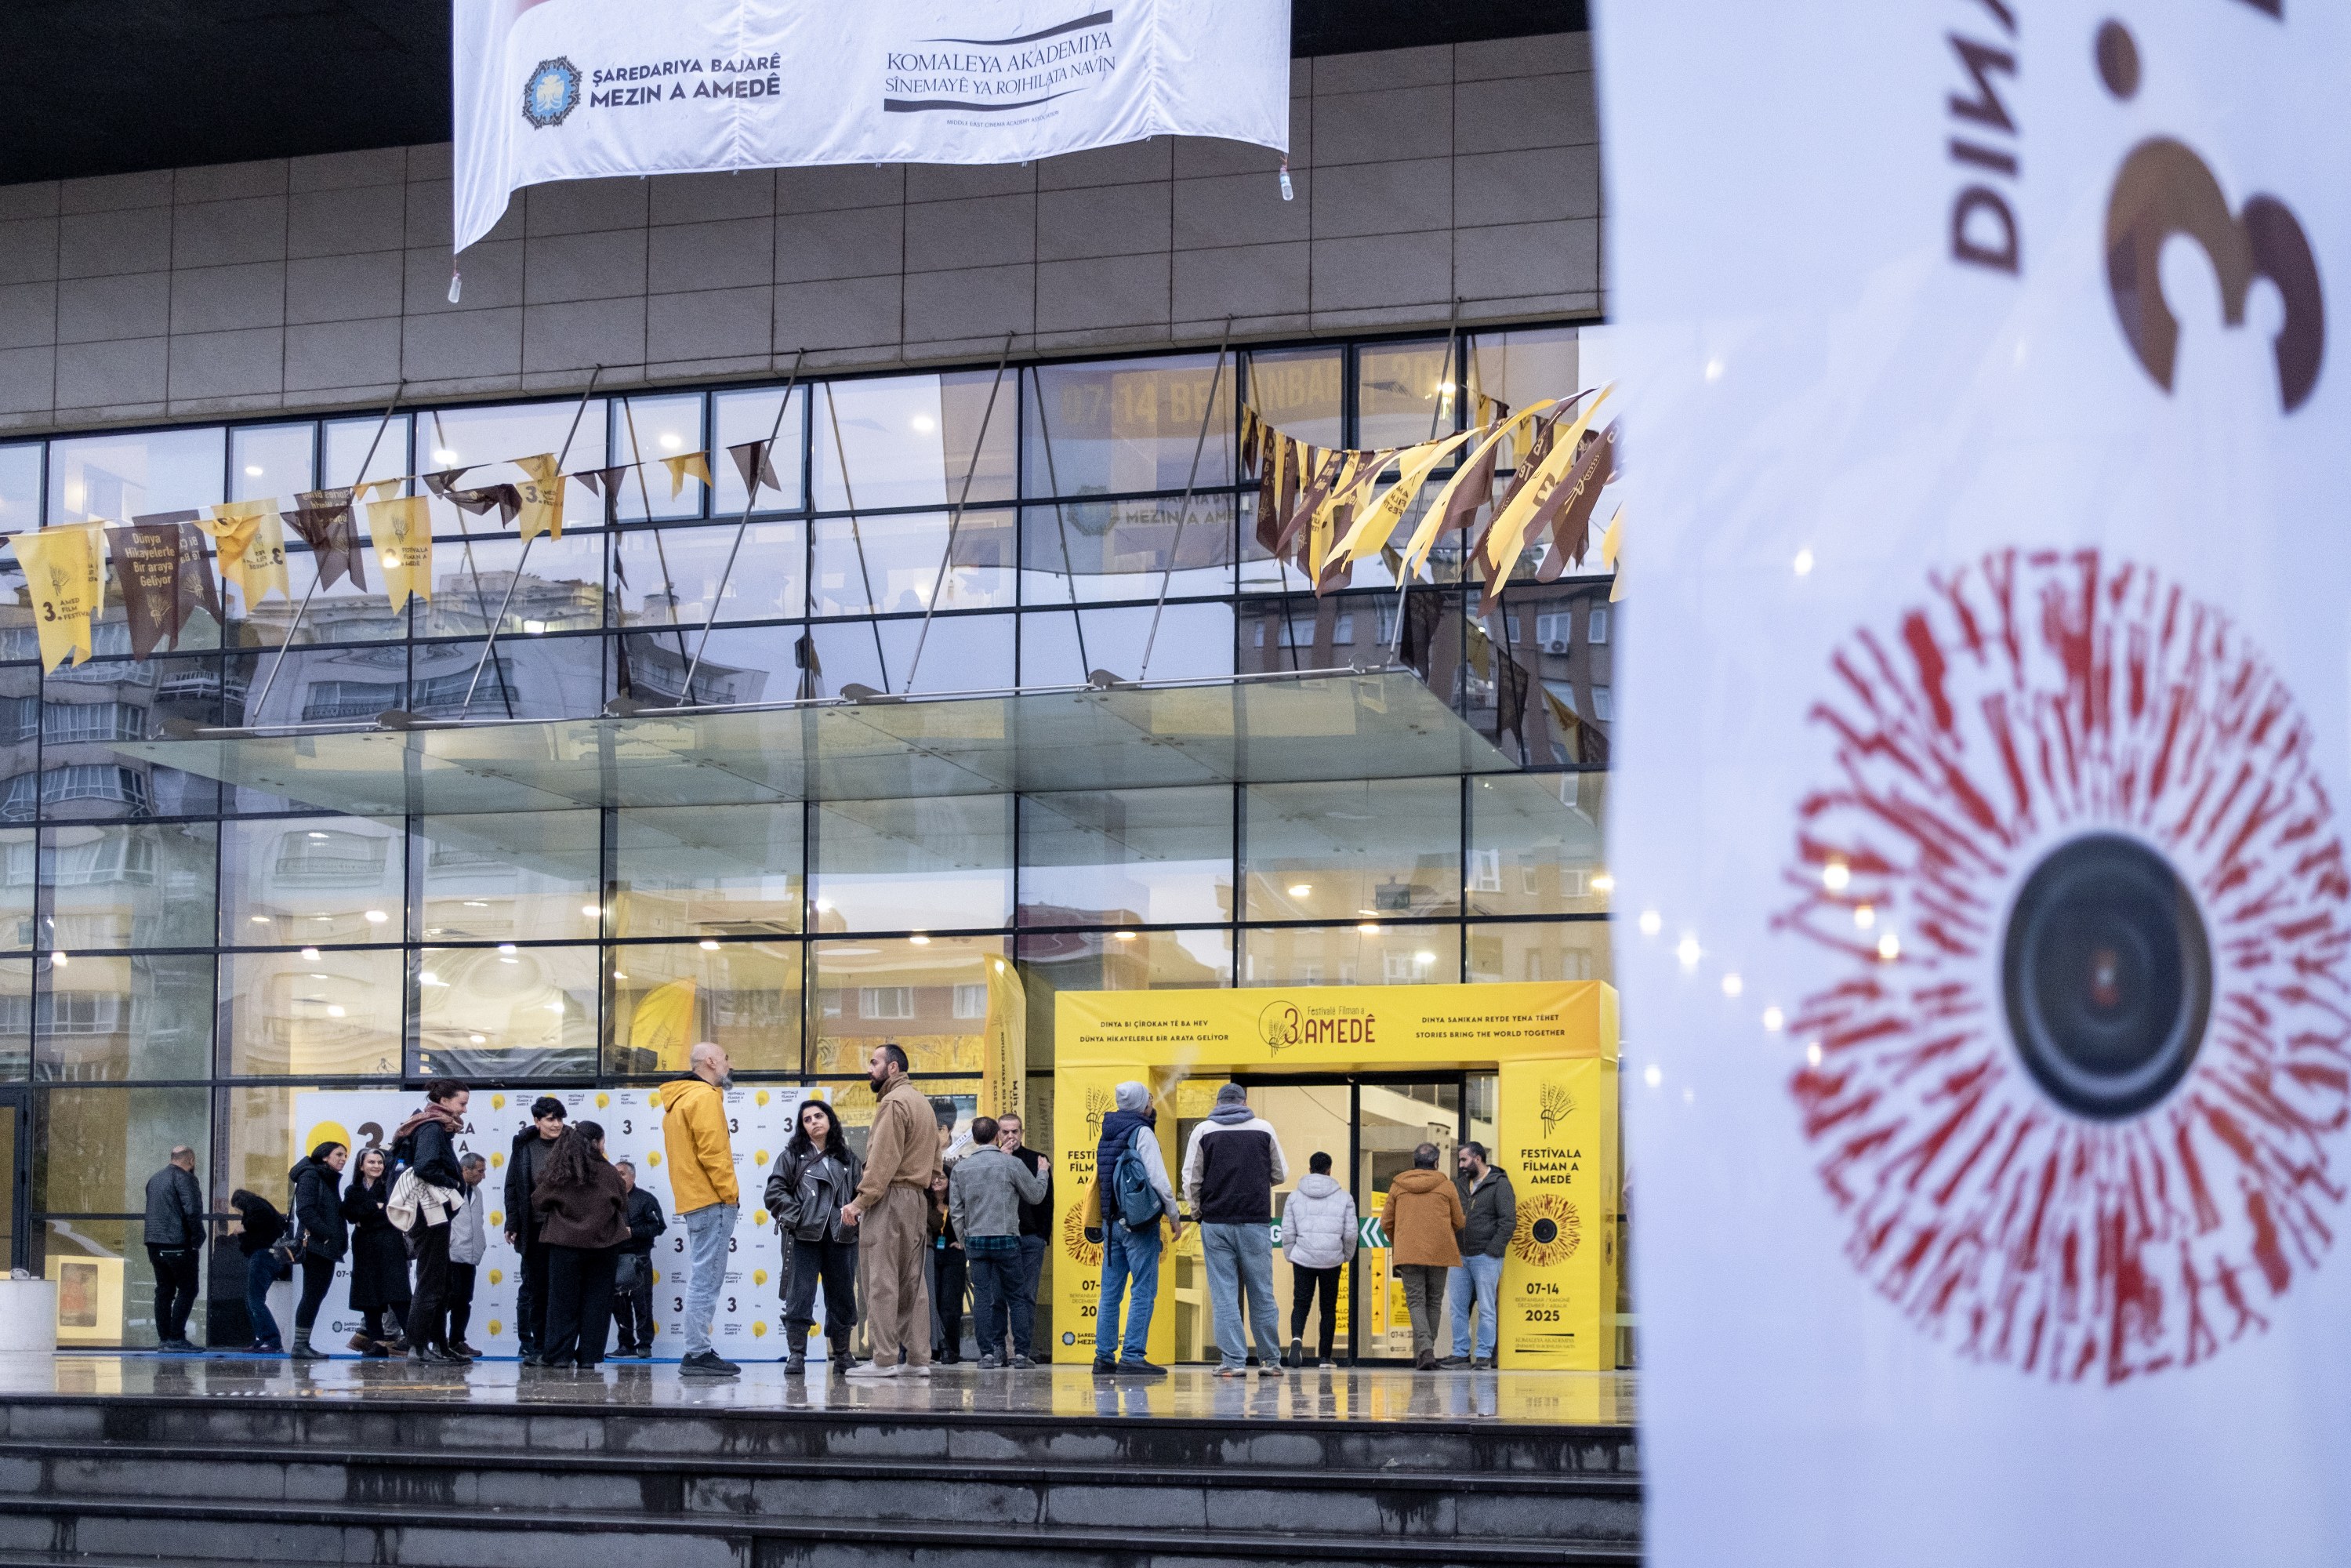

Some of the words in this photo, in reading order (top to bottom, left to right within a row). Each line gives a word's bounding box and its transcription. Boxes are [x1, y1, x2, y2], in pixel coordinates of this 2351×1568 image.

[887, 53, 1003, 73] KOMALEYA
[1007, 31, 1112, 72] AKADEMIYA
[593, 59, 703, 87] ŞAREDARIYA
[711, 53, 781, 73] BAJARÊ
[885, 75, 969, 93] SÎNEMAYÊ
[974, 81, 992, 95] YA
[996, 67, 1068, 96] ROJHILATA
[1070, 55, 1116, 78] NAVÎN
[590, 84, 662, 107] MEZIN
[669, 82, 686, 100] A
[693, 72, 780, 99] AMEDÊ
[1007, 118, 1030, 126] ACADEMY
[132, 532, 161, 546] Dünya
[125, 546, 175, 561] Hikayelerle
[133, 561, 146, 573] Bir
[147, 561, 174, 575] araya
[140, 575, 172, 589] Geliyor
[43, 601, 63, 622] 3.
[1305, 1013, 1376, 1044] AMEDÊ
[622, 1120, 633, 1134] 3
[730, 1118, 739, 1134] 3
[783, 1117, 793, 1133] 3
[1068, 1149, 1095, 1160] FESTÎ
[1521, 1147, 1582, 1158] FESTÎVALA
[1070, 1161, 1094, 1172] FÎLM
[1523, 1160, 1567, 1171] FÎLMAN
[1571, 1162, 1580, 1171] A
[1530, 1173, 1572, 1184] AMEDÊ
[673, 1237, 684, 1253] 3
[1082, 1280, 1100, 1290] 07-
[1526, 1283, 1559, 1294] 07-14
[673, 1297, 684, 1312] 3
[727, 1297, 737, 1312] 3
[1081, 1306, 1097, 1316] 20
[1526, 1310, 1560, 1321] 2025
